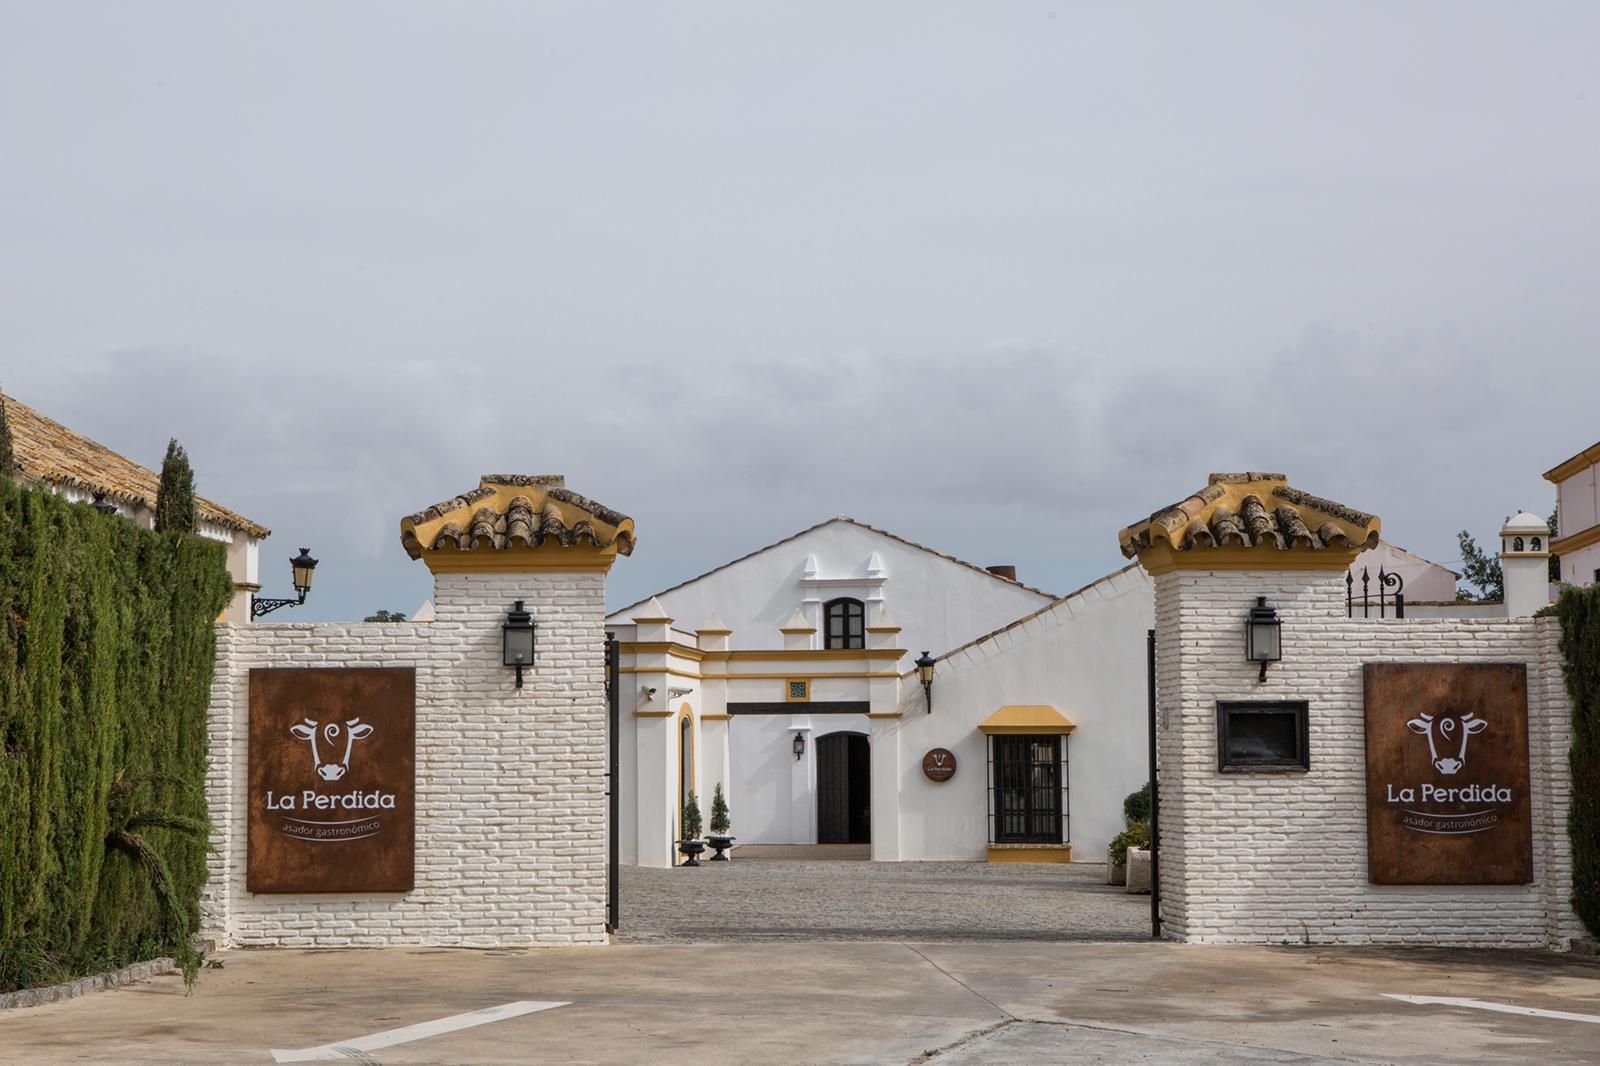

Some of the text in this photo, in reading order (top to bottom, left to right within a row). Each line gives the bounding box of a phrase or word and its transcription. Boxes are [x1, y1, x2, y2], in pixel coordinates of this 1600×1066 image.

[266, 790, 396, 809] La Perdida
[1387, 784, 1512, 802] La Perdida
[282, 821, 380, 838] asador gastronómico
[1403, 815, 1433, 827] asador
